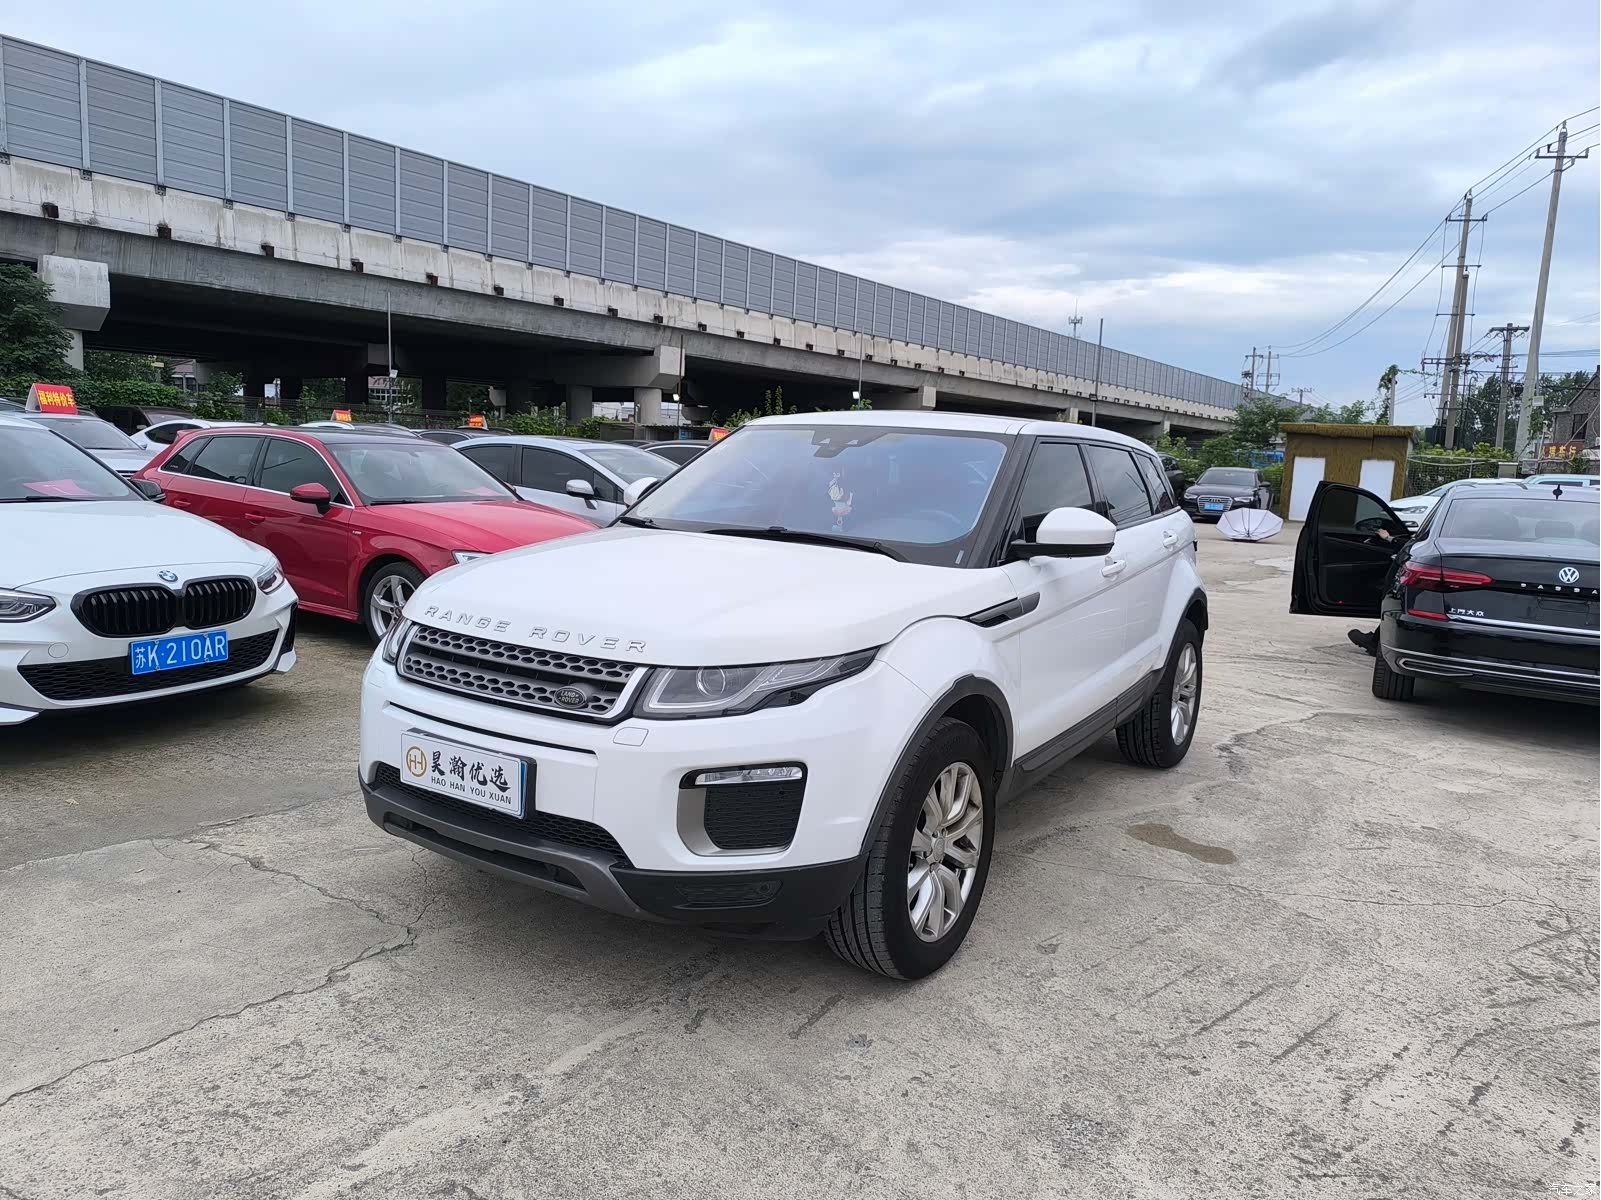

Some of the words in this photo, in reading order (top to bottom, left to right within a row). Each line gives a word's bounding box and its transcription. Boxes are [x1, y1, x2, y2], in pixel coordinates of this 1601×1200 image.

[425, 605, 511, 632] RANGE
[529, 626, 646, 653] ROVER
[560, 690, 576, 698] LAND
[561, 696, 580, 704] ROVER
[431, 750, 511, 793] 昊瀚优选
[431, 775, 447, 787] HAO
[449, 781, 466, 792] HAN
[470, 786, 486, 798] YOU
[489, 791, 512, 805] XUAN
